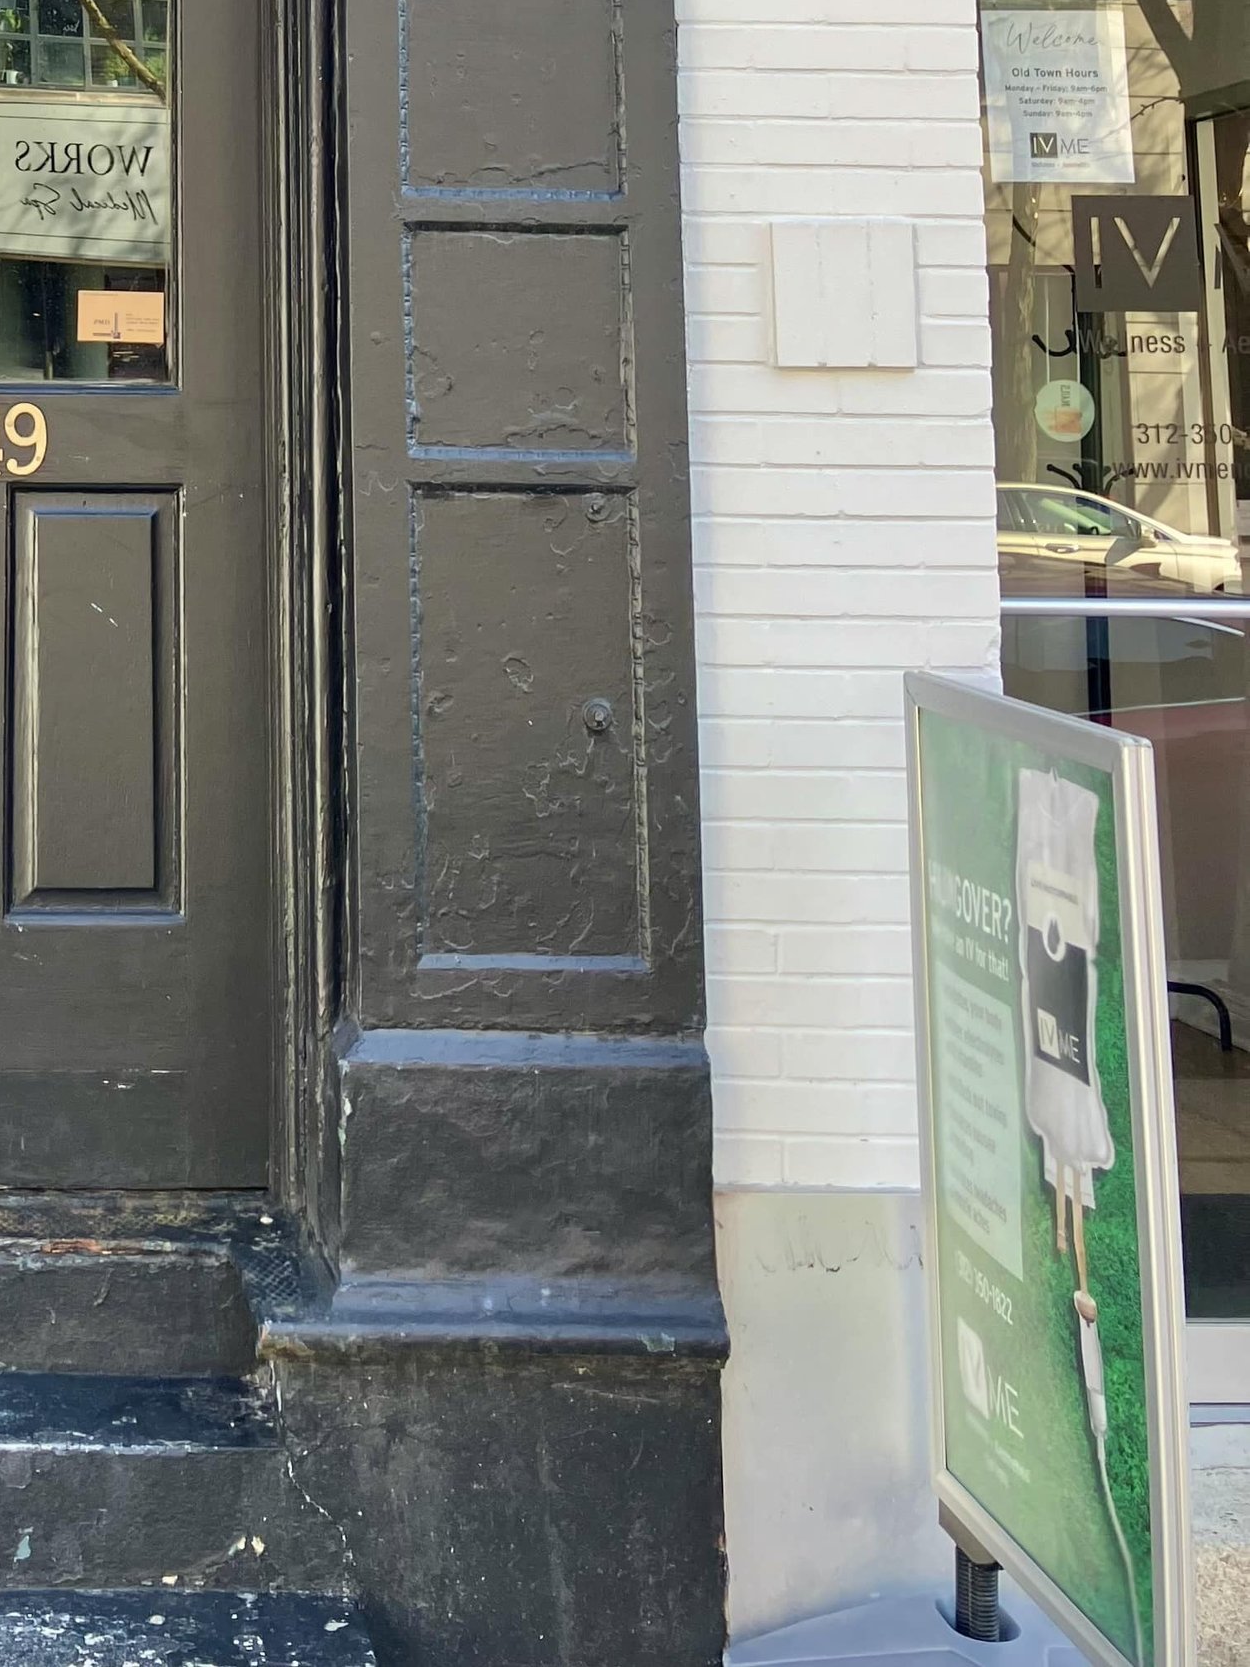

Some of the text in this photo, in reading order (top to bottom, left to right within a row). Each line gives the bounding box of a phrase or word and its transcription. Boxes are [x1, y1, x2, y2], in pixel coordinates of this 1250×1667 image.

[1006, 21, 1099, 54] Welcome
[1012, 67, 1099, 78] Old Town Hours
[1005, 85, 1034, 93] Monday
